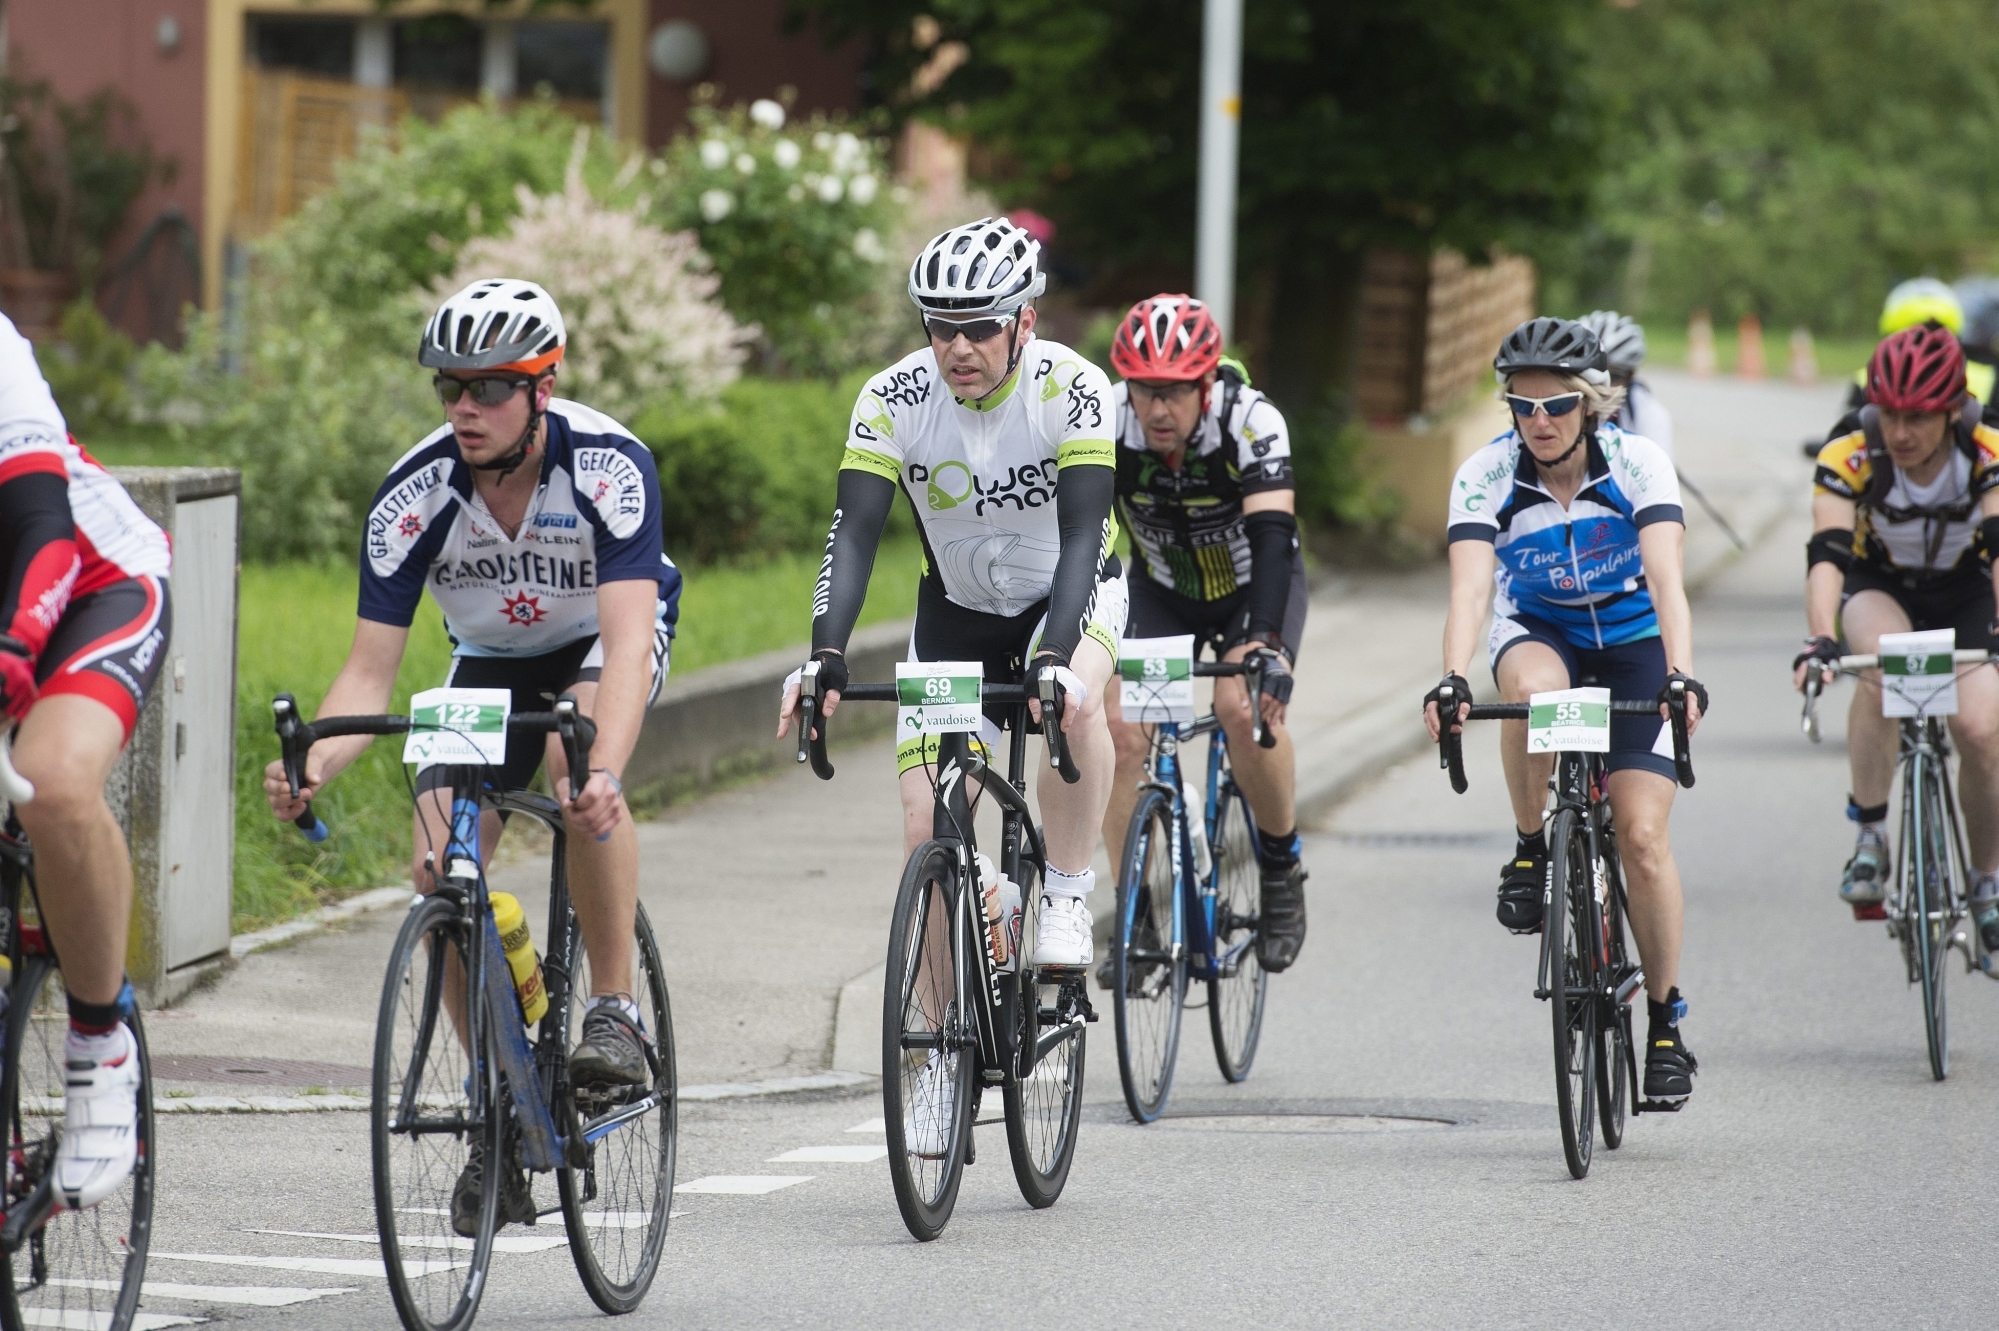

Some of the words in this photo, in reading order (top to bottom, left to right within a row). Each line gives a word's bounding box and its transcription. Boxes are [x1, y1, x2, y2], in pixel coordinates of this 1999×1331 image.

[1513, 547, 1563, 570] Tour
[435, 550, 597, 590] GEROLSTEINE
[1143, 658, 1168, 676] 53
[925, 677, 952, 697] 69
[921, 696, 957, 705] BERNARD
[435, 703, 481, 725] 122
[926, 713, 976, 726] vaudoise
[1556, 702, 1582, 720] 55
[1554, 734, 1604, 746] vaudoise
[1591, 858, 1604, 905] BMC
